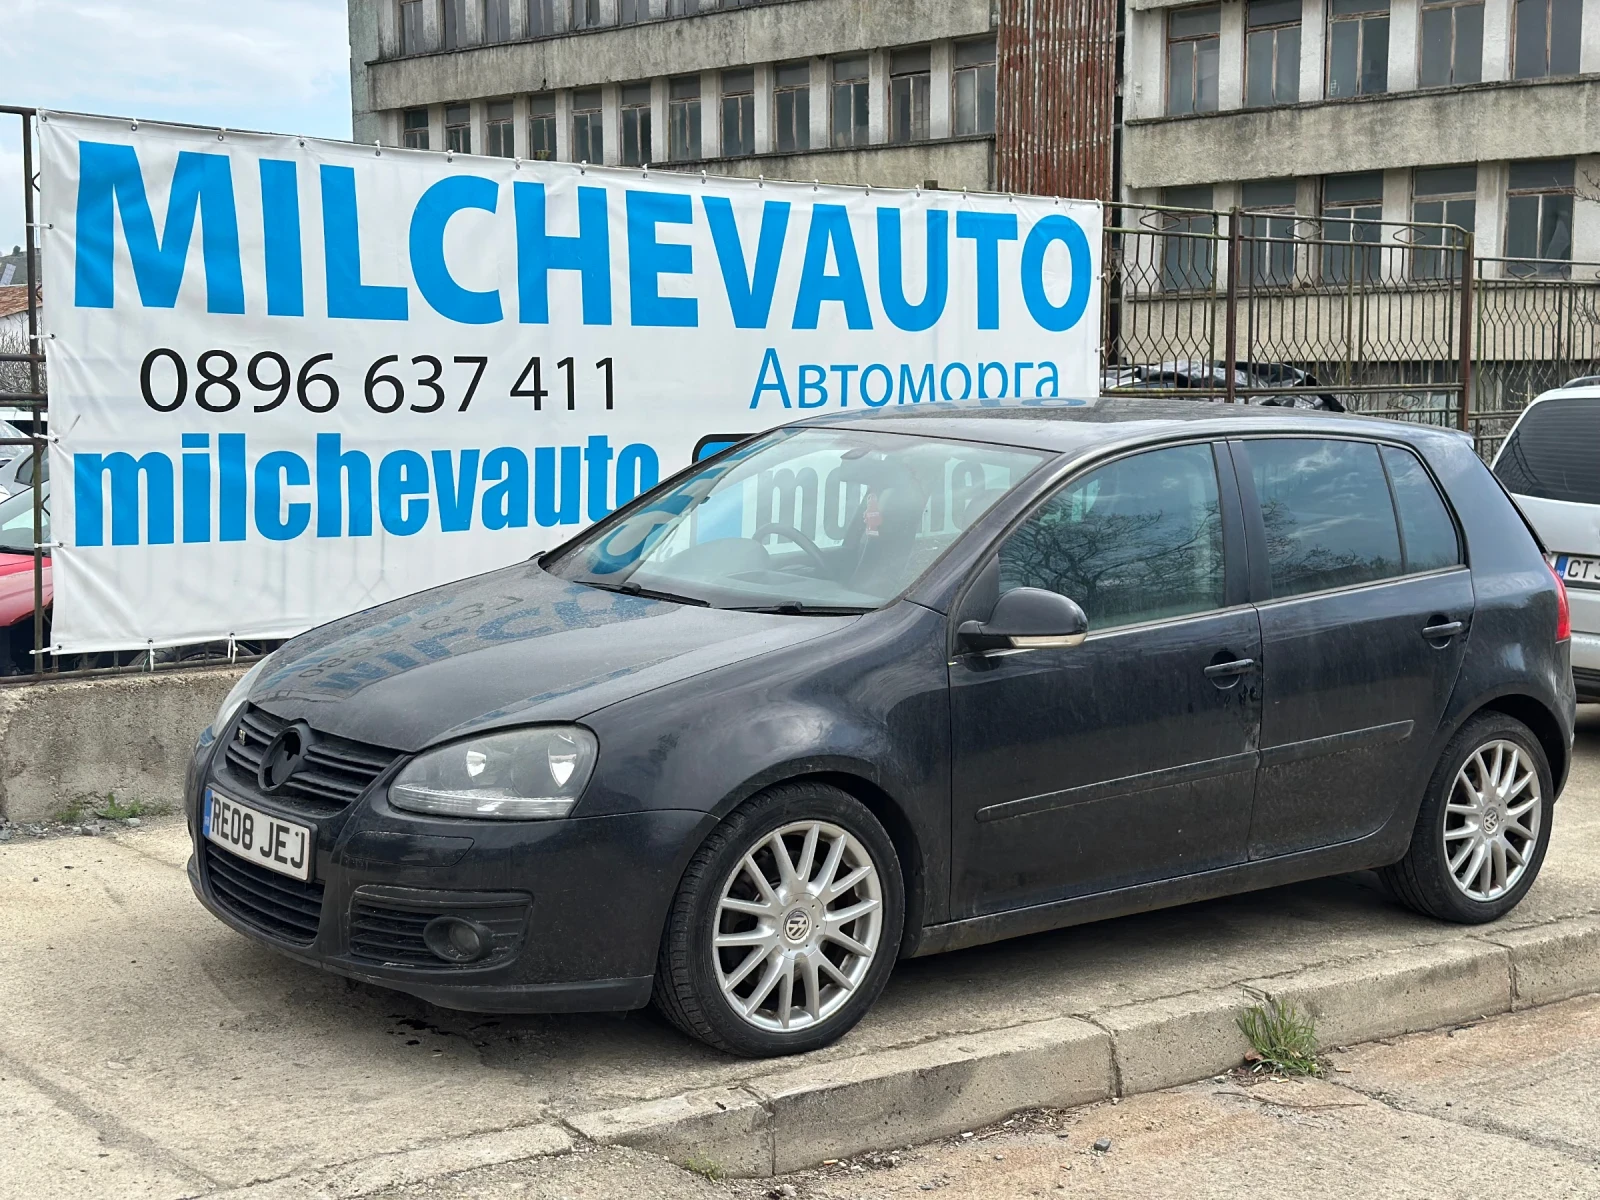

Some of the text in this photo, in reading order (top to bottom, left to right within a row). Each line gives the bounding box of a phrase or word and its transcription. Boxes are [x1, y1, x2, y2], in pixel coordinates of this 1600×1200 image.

[75, 141, 1091, 332] MILCHEVAUTO
[140, 348, 616, 414] 0896 637 411
[750, 347, 1059, 409] Автоморга
[212, 797, 254, 850] RE08
